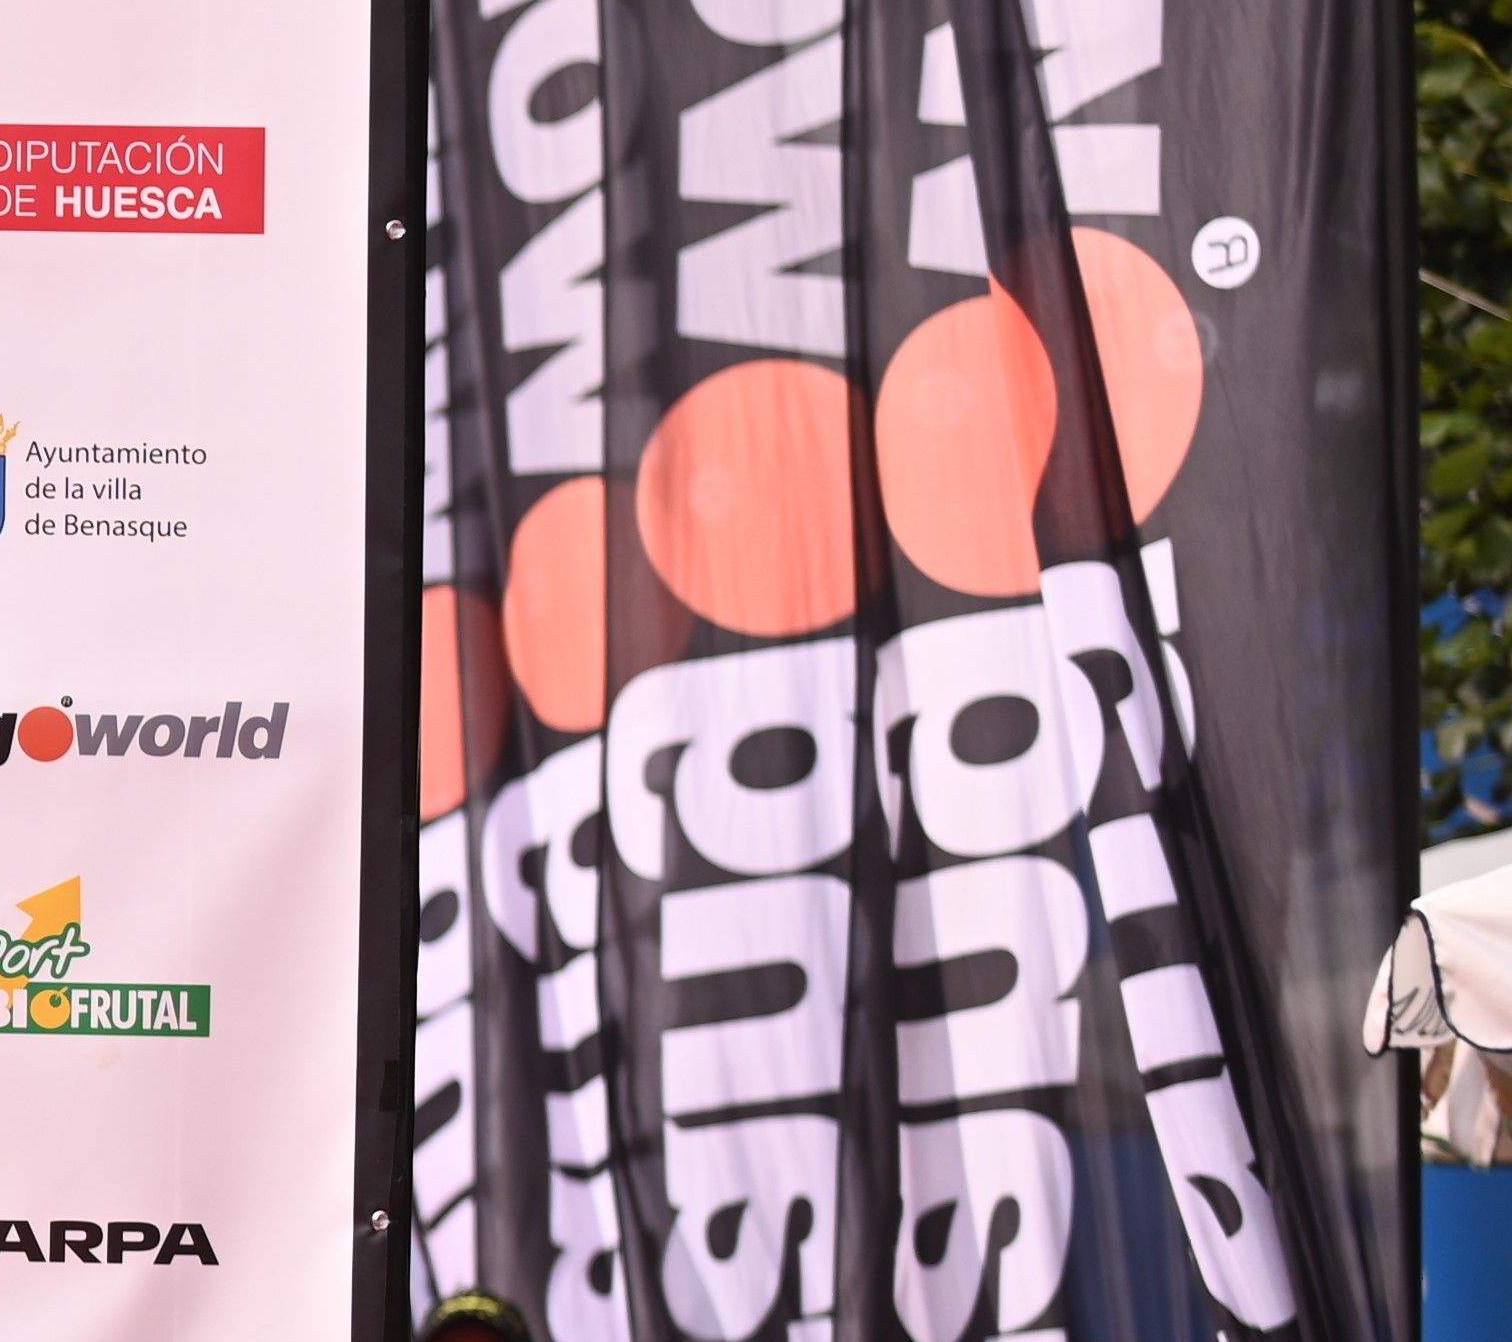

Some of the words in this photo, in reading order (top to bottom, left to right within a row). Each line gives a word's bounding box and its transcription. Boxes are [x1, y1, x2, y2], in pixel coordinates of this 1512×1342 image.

[55, 186, 222, 220] HUESCA
[26, 440, 207, 467] Ayuntamiento
[25, 477, 56, 500] de
[64, 478, 84, 500] la
[92, 478, 142, 501] villa
[25, 513, 56, 537] de
[65, 515, 187, 542] Benasque
